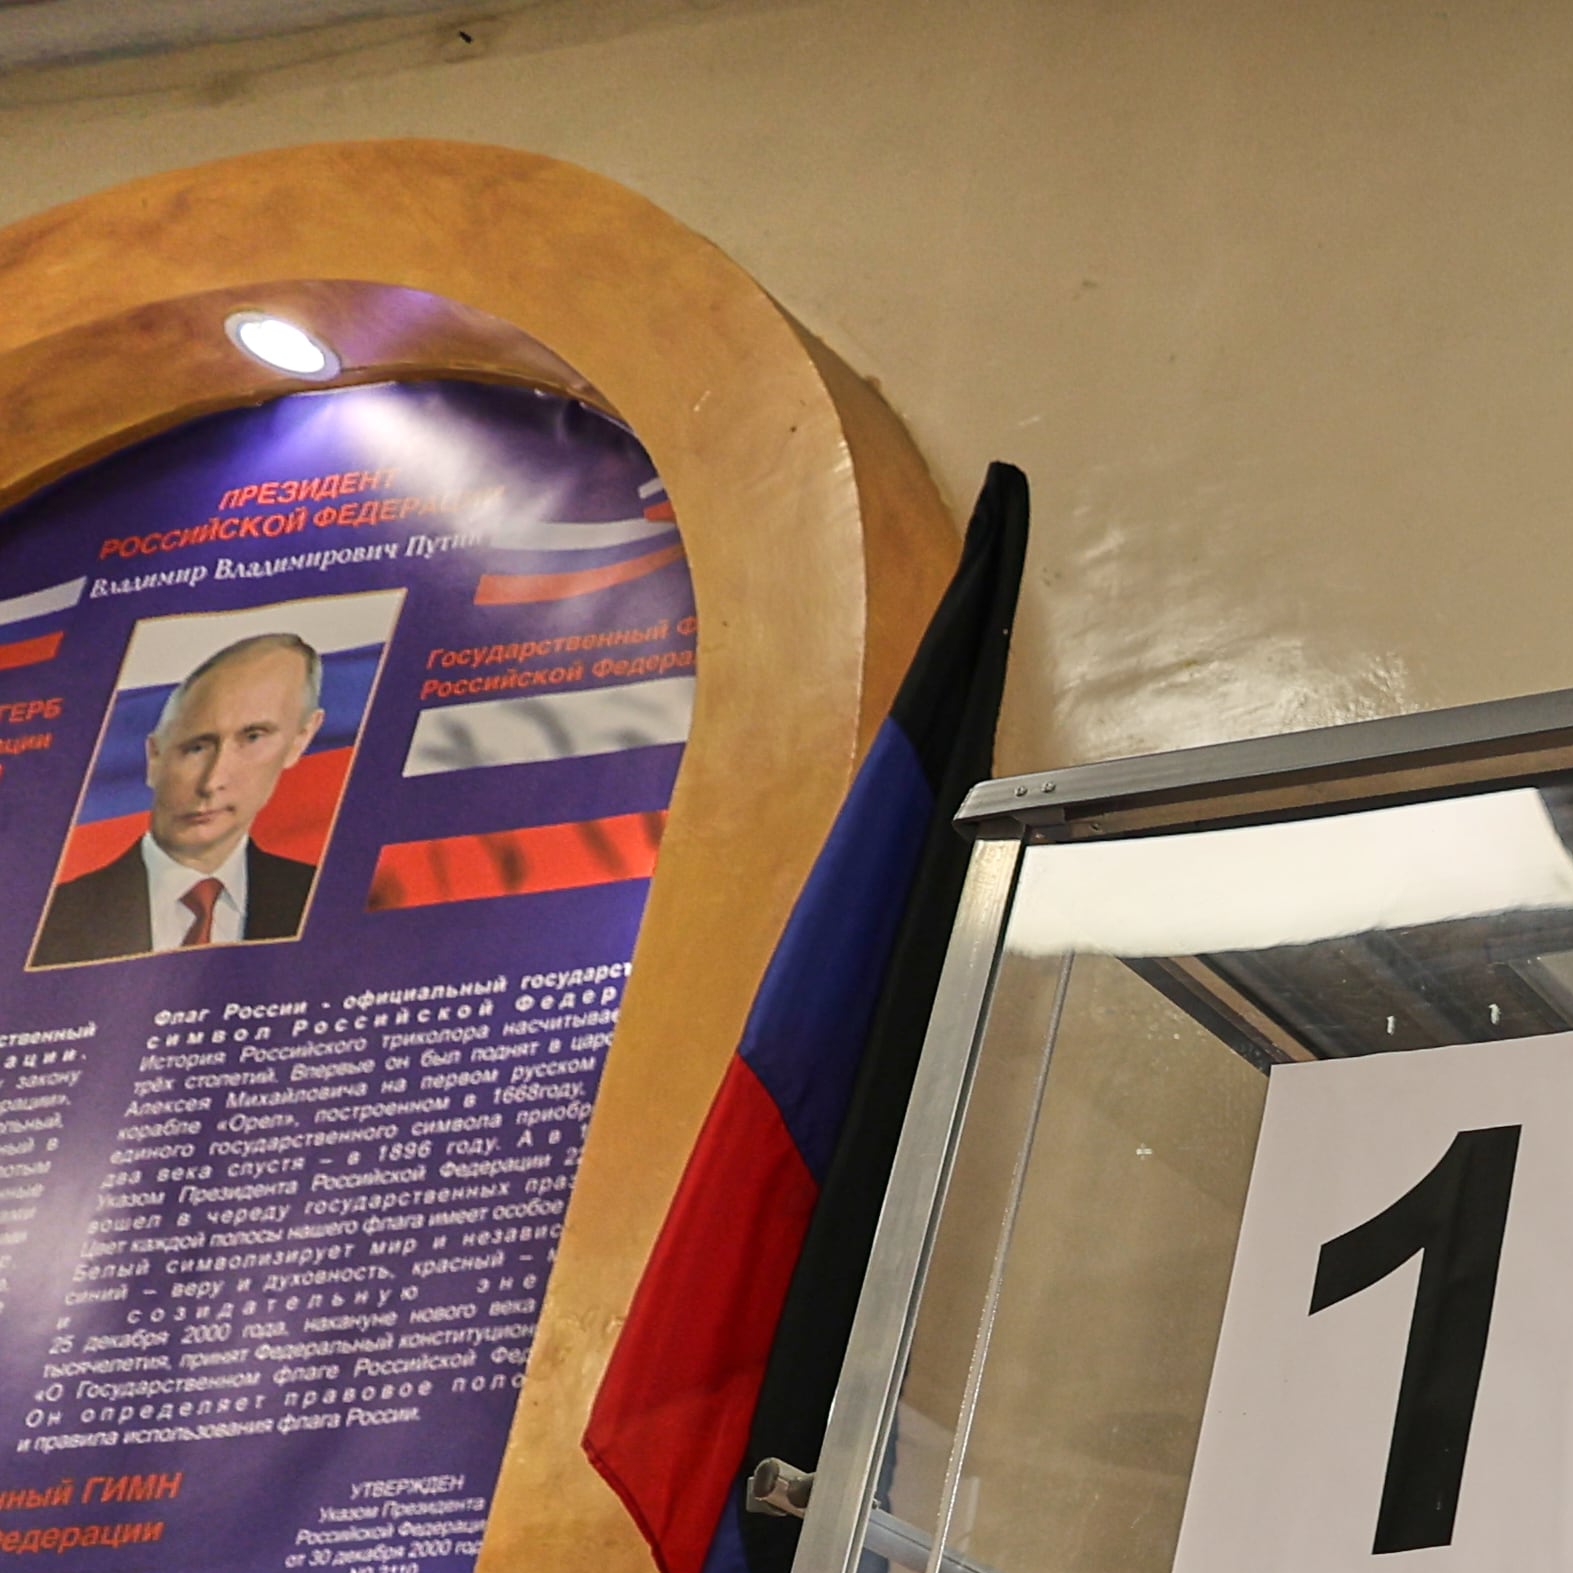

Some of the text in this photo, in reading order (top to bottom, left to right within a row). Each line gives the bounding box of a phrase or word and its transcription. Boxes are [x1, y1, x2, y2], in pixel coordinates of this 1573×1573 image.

[218, 467, 399, 511] ПРЕЗИДЕНТ
[99, 506, 307, 560] РОССИЙСКОЙ
[90, 564, 209, 599] Владимир
[214, 542, 399, 580] Владимирович
[426, 619, 669, 670] Государственный
[420, 660, 585, 700] Российской
[147, 986, 617, 1049] символ Российской Федер
[154, 1008, 211, 1026] Флаг
[223, 1001, 308, 1020] России
[343, 975, 509, 1011] официальный
[139, 1051, 227, 1072] История
[239, 1038, 368, 1063] Российского
[382, 1024, 490, 1050] триколора
[290, 1059, 375, 1082] Впервые
[385, 1055, 411, 1071] он
[420, 1048, 461, 1068] был
[470, 1039, 540, 1062] поднят
[548, 1038, 560, 1053] в
[124, 1057, 596, 1117] Алексея Михайловича на первом русском
[110, 1142, 195, 1164] единого
[209, 1124, 398, 1157] государственного
[411, 1113, 502, 1137] символа
[116, 1118, 202, 1141] корабле
[314, 1096, 450, 1124] построенном
[463, 1094, 476, 1109] в
[156, 1165, 213, 1182] века
[227, 1157, 305, 1178] спустя
[347, 1150, 360, 1165] в
[378, 1139, 432, 1162] 1896
[516, 1129, 533, 1147] А
[548, 1129, 561, 1145] в
[176, 1212, 191, 1227] в
[207, 1203, 290, 1226] череду
[304, 1181, 510, 1216] государственных
[178, 1180, 299, 1206] Президента
[311, 1164, 427, 1191] Российской
[439, 1154, 552, 1178] Федерации
[131, 1232, 206, 1253] каждой
[209, 1228, 284, 1248] полосы
[287, 1219, 358, 1241] нашего
[362, 1213, 424, 1235] флага
[428, 1207, 489, 1226] имеет
[492, 1197, 565, 1219] особое
[72, 1259, 150, 1282] Белый
[165, 1243, 355, 1274] символизирует
[369, 1238, 418, 1256] мир
[432, 1236, 447, 1249] и
[171, 1279, 225, 1298] веру
[237, 1278, 252, 1292] и
[412, 1250, 505, 1277] красный
[49, 1334, 75, 1354] 25
[83, 1329, 170, 1353] декабря
[180, 1323, 231, 1344] 2000
[304, 1311, 398, 1332] накануне
[410, 1303, 477, 1324] нового
[489, 1298, 537, 1317] века
[127, 1285, 419, 1324] созидательную
[179, 1348, 250, 1370] принят
[254, 1331, 395, 1361] Федеральный
[1308, 1124, 1522, 1555] 1
[76, 1371, 260, 1401] Государственном
[273, 1364, 340, 1386] флаге
[354, 1349, 477, 1377] Российской
[25, 1408, 63, 1428] Он
[80, 1394, 266, 1424] определяет
[284, 1380, 433, 1409] правовое
[16, 1438, 32, 1452] и
[34, 1430, 119, 1453] правила
[123, 1418, 274, 1444] использования
[277, 1411, 341, 1434] флага
[81, 1471, 183, 1504] ГИМН
[318, 1497, 486, 1523] Указом Президента
[351, 1474, 465, 1500] УТВЕРЖДЕН
[285, 1554, 306, 1568] от
[308, 1549, 332, 1566] 30
[332, 1543, 405, 1566] декабря
[407, 1538, 452, 1558] 2000
[295, 1522, 395, 1545] Российской
